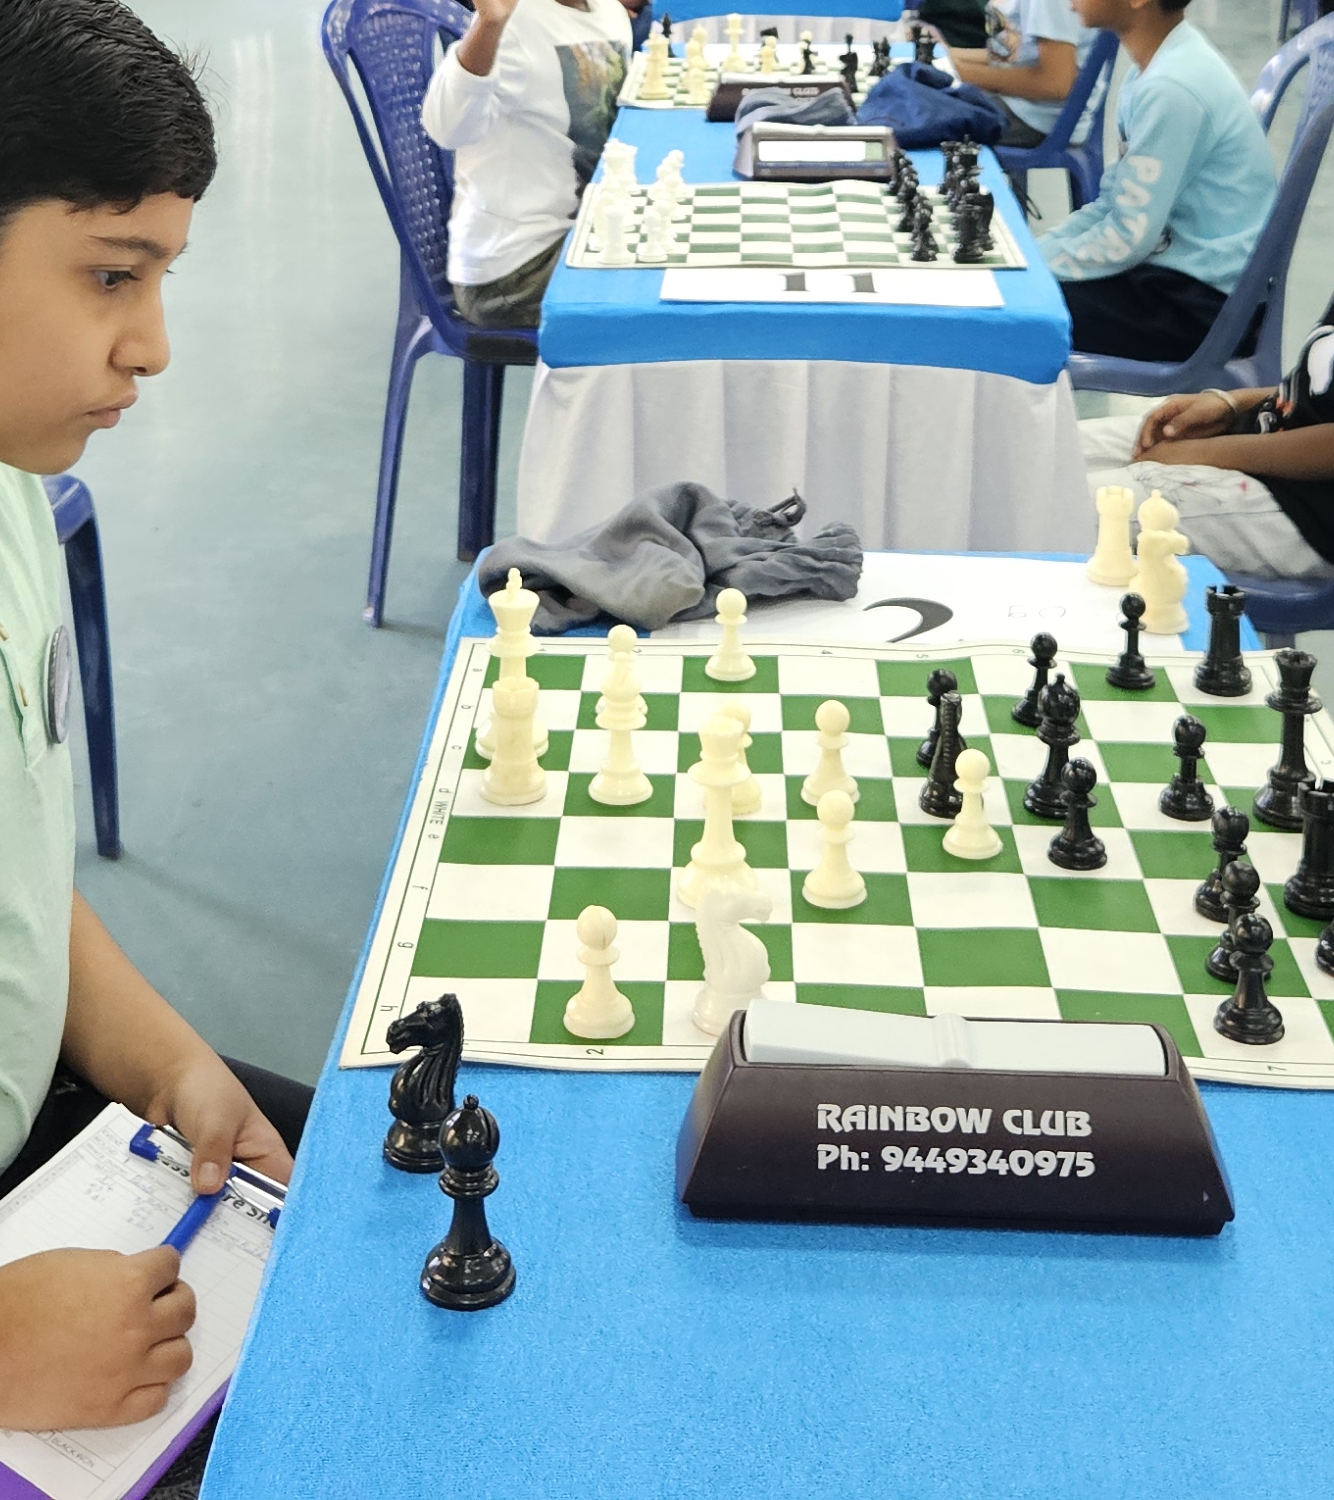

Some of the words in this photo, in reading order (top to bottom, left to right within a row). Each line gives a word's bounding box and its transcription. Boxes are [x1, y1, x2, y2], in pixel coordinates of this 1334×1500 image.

[429, 800, 449, 826] WHITE
[816, 1102, 993, 1136] RAINBOW
[1002, 1108, 1092, 1137] CLUB
[816, 1142, 871, 1173] Ph:
[880, 1145, 1096, 1177] 9449340975
[50, 1436, 76, 1458] BLACK
